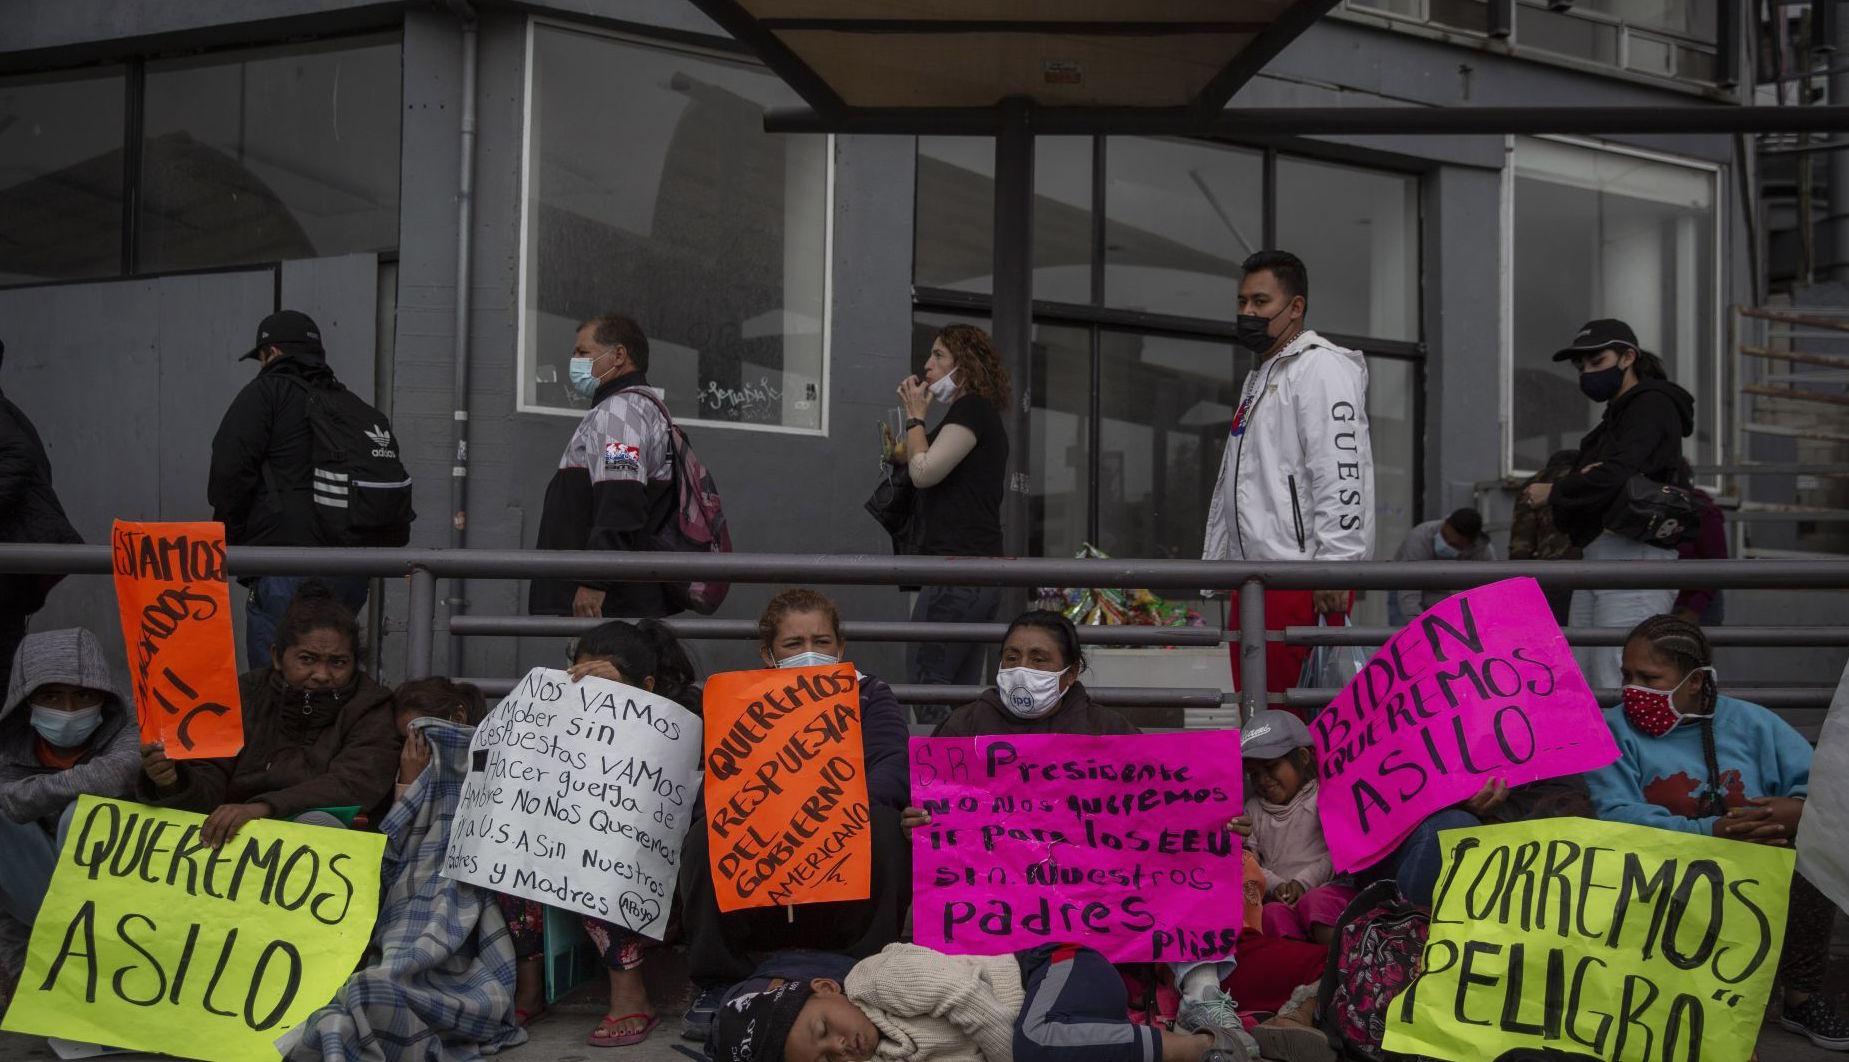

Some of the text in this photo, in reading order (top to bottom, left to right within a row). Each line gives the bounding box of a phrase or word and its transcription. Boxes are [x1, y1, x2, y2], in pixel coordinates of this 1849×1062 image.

[371, 448, 396, 458] adidas
[1331, 401, 1361, 530] GUESS
[113, 527, 228, 583] ESTAMOS
[708, 669, 857, 782] QUEREMOS
[1012, 694, 1032, 707] ipg
[1315, 596, 1485, 753] BIDEN
[1322, 647, 1555, 781] QUEREMOS
[653, 801, 675, 830] de
[711, 703, 862, 839] RESPUESTA
[735, 756, 856, 899] GOBIERNO
[74, 802, 354, 926] QUEREMOS
[512, 868, 610, 917] Madres
[717, 824, 780, 881] DEL
[767, 801, 871, 906] AMERICANO
[1431, 836, 1773, 984] CORREMOS
[38, 900, 303, 1032] ASILO
